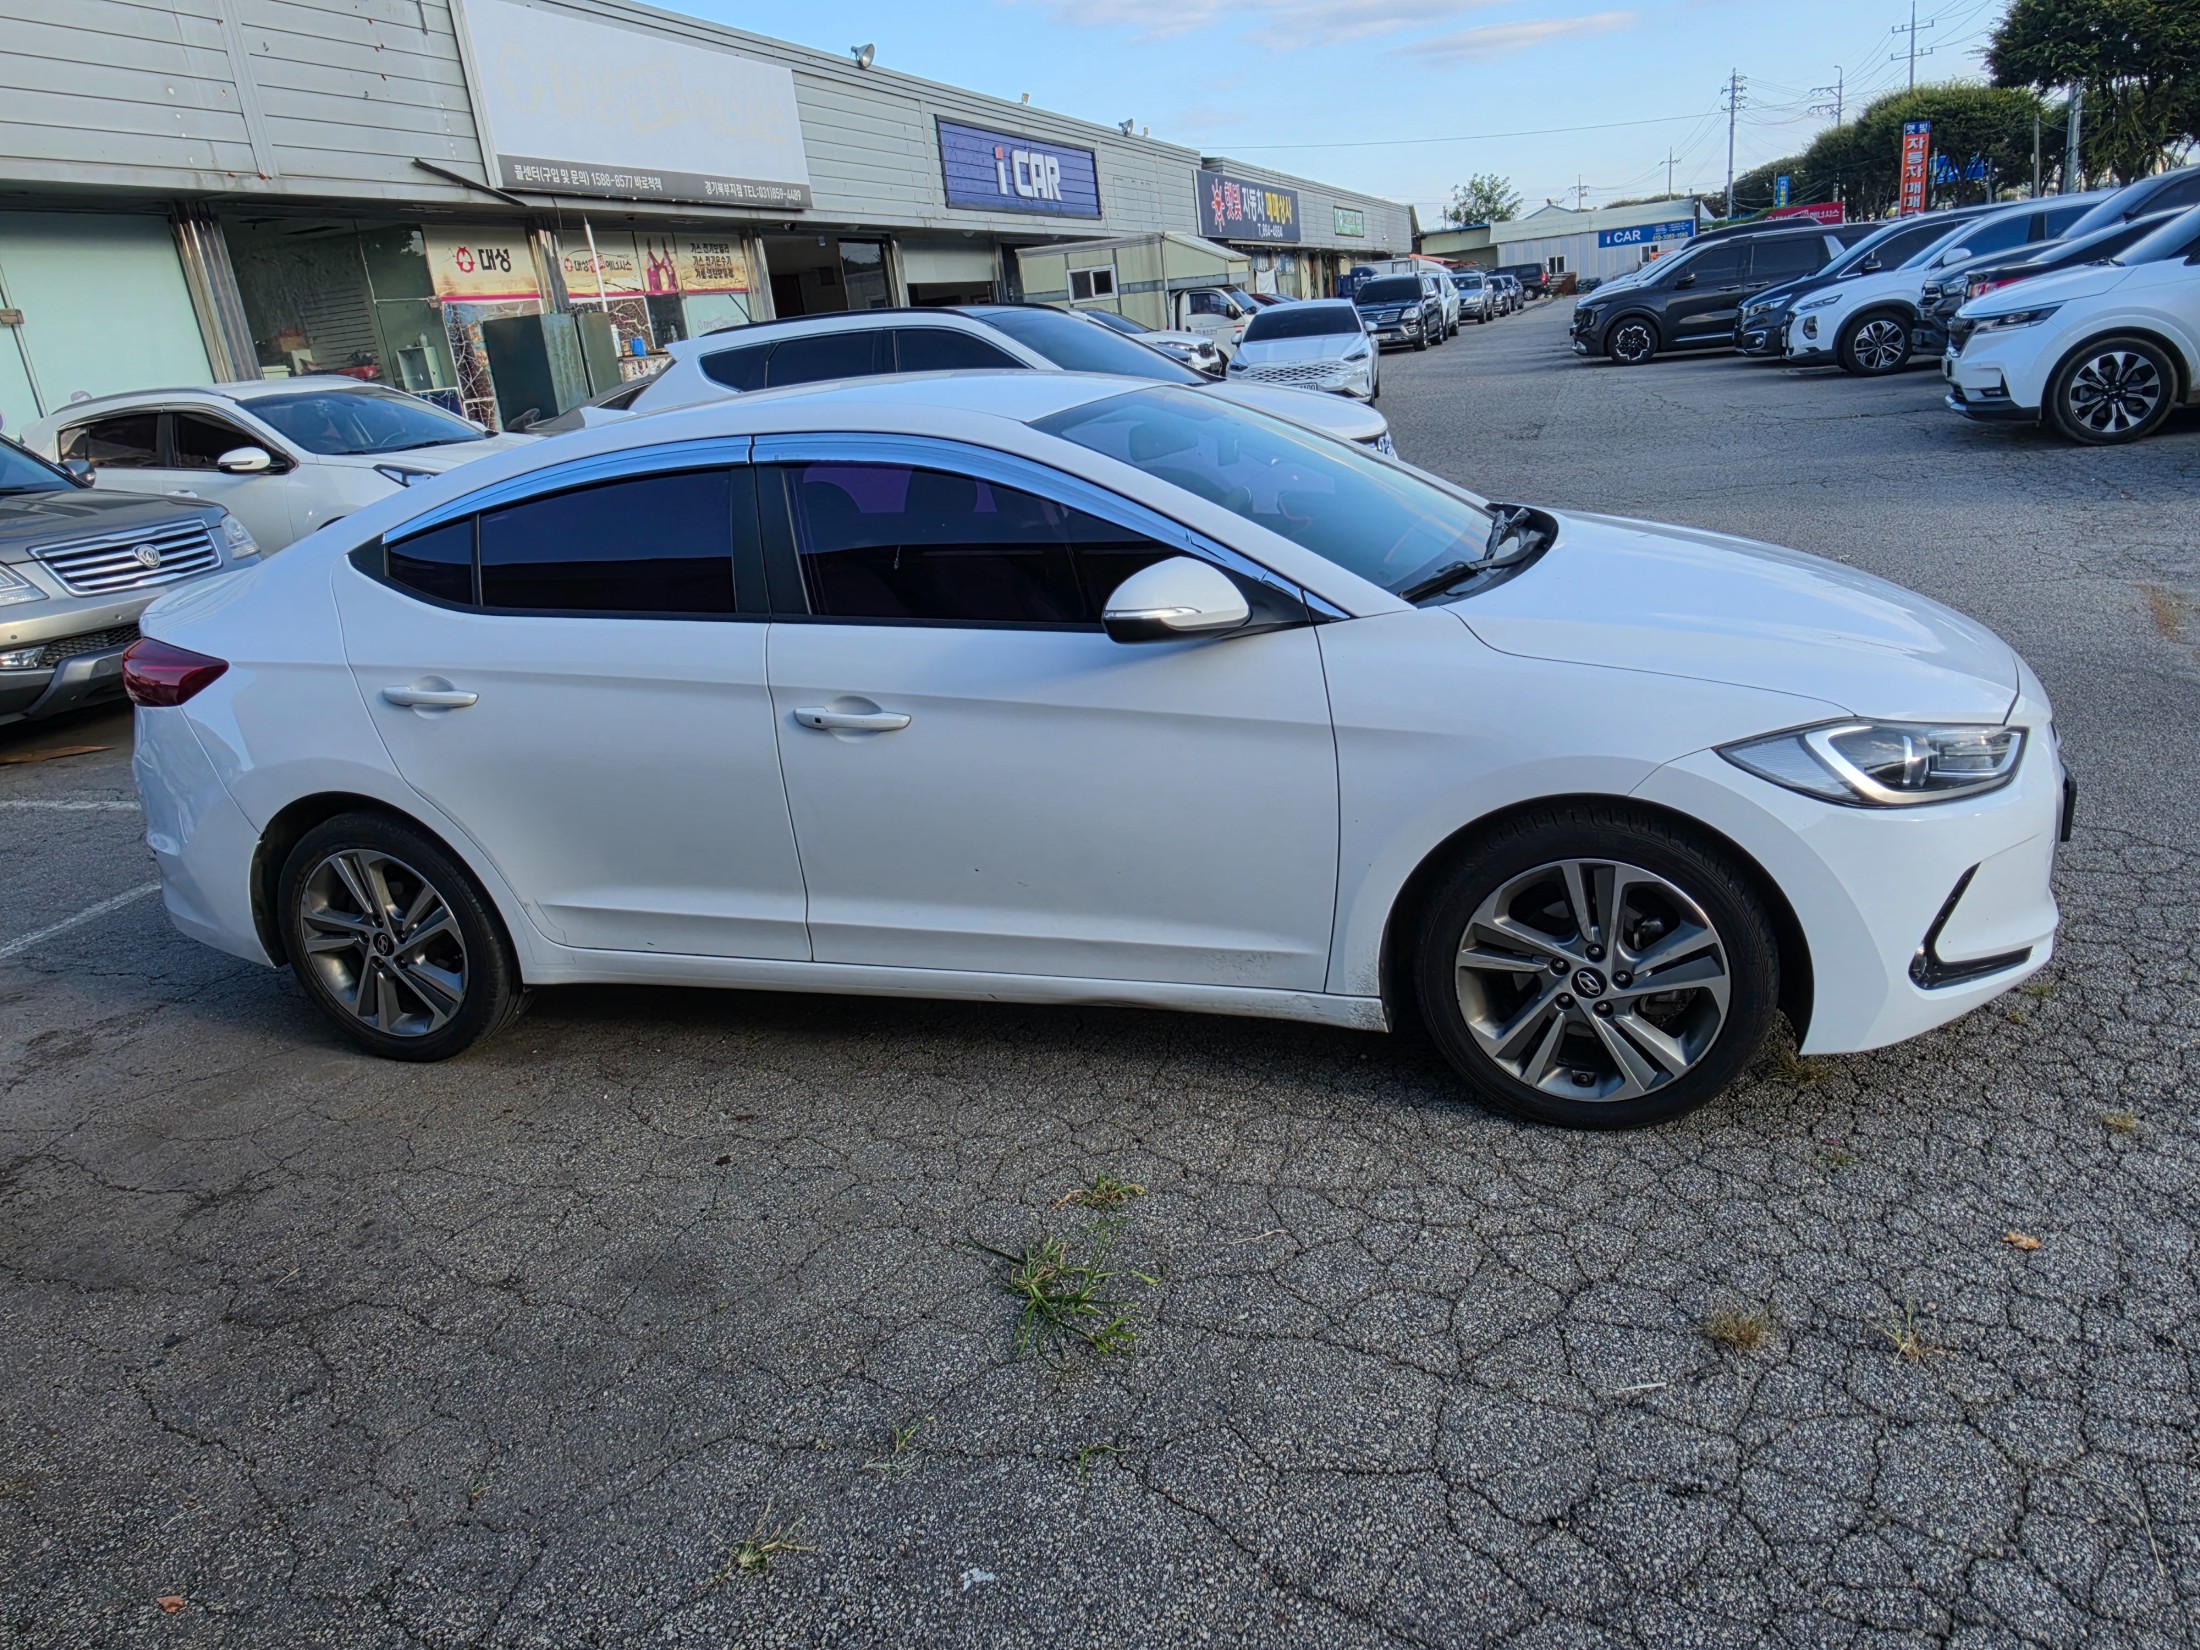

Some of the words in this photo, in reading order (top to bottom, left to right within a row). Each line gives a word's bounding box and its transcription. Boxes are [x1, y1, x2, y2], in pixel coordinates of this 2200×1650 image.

[1011, 149, 1063, 201] CAR
[1904, 137, 1926, 214] 자동차매매
[1613, 229, 1641, 244] CAR
[477, 248, 512, 273] 대성
